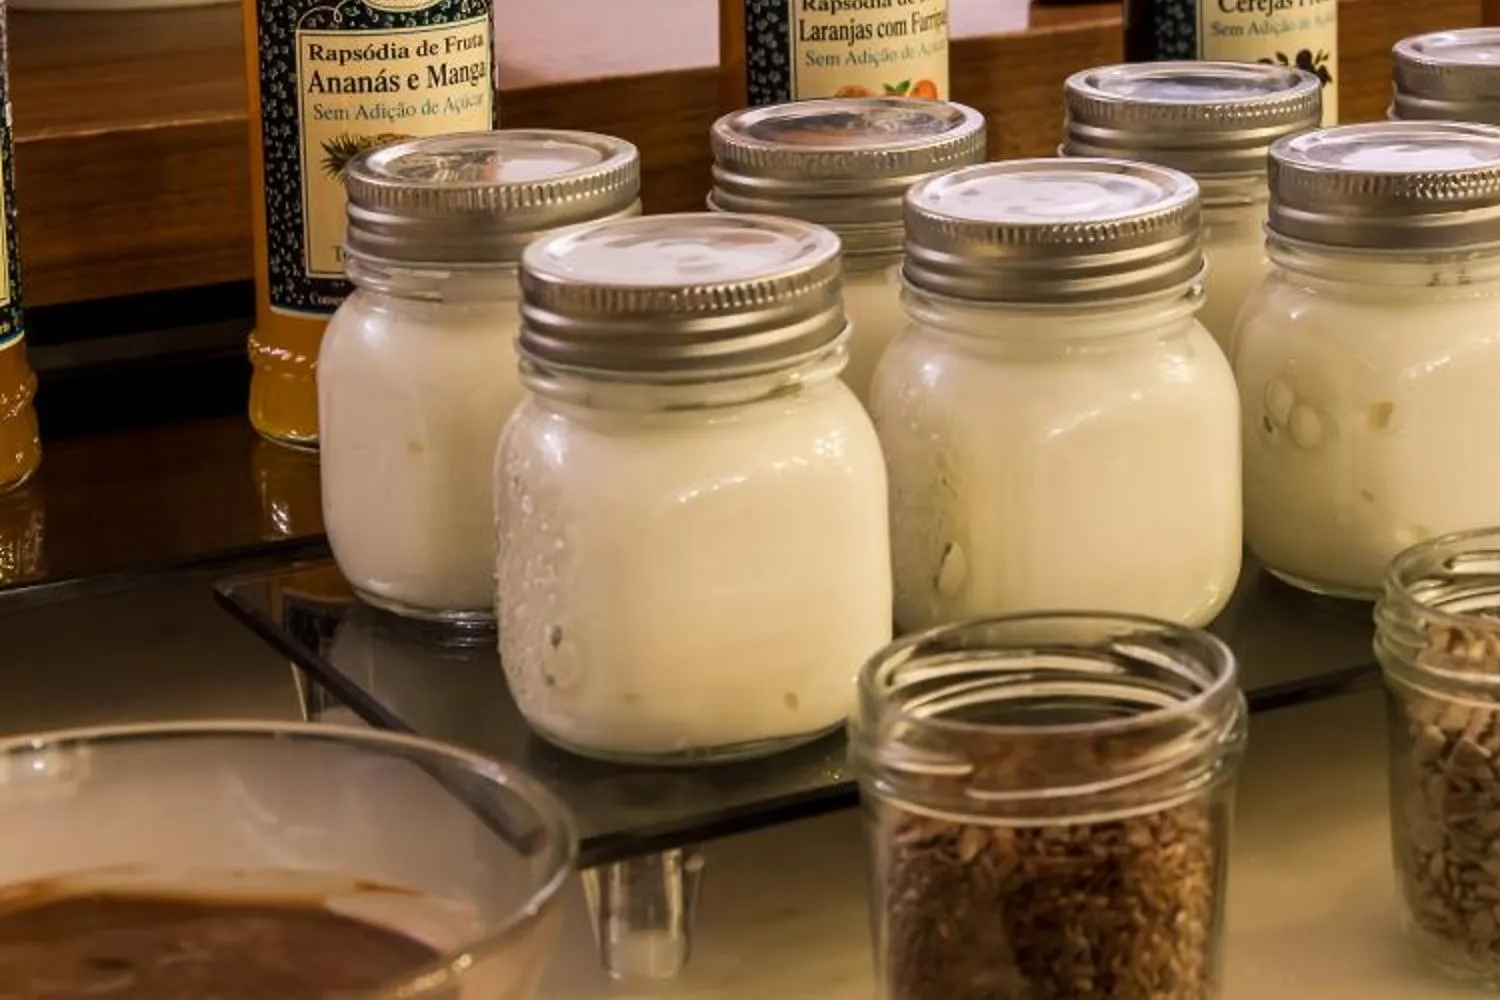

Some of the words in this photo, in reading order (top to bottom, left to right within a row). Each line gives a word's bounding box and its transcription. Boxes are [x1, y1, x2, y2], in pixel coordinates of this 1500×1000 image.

[799, 18, 873, 47] Laranjas
[877, 19, 908, 38] com
[308, 41, 410, 67] Rapsódia
[416, 37, 440, 59] de
[444, 30, 485, 55] Fruta
[805, 50, 841, 67] Sem
[308, 67, 400, 96] Ananás
[407, 71, 420, 91] e
[427, 58, 488, 91] Manga
[313, 102, 349, 122] Sem
[355, 99, 417, 125] Adição
[421, 97, 439, 117] de
